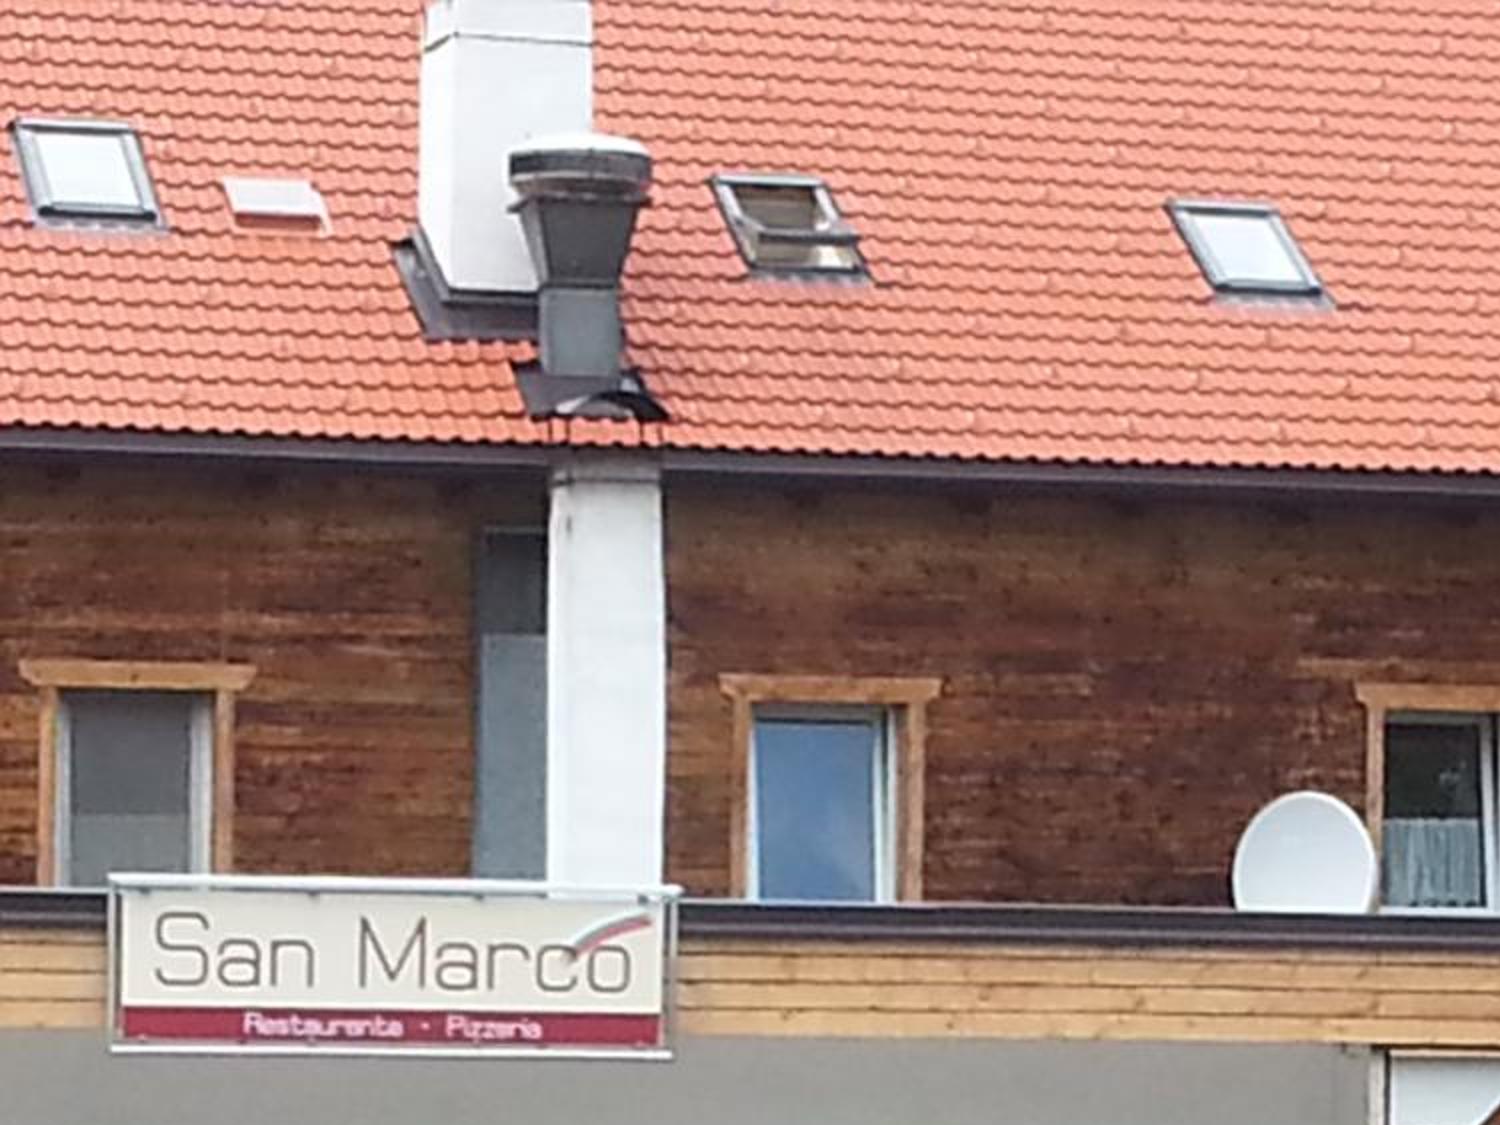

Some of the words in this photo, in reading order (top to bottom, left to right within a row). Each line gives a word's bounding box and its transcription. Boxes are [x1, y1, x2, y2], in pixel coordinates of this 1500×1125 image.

[154, 910, 316, 989] San
[358, 914, 632, 994] Marco
[445, 1013, 543, 1040] Pizzeria
